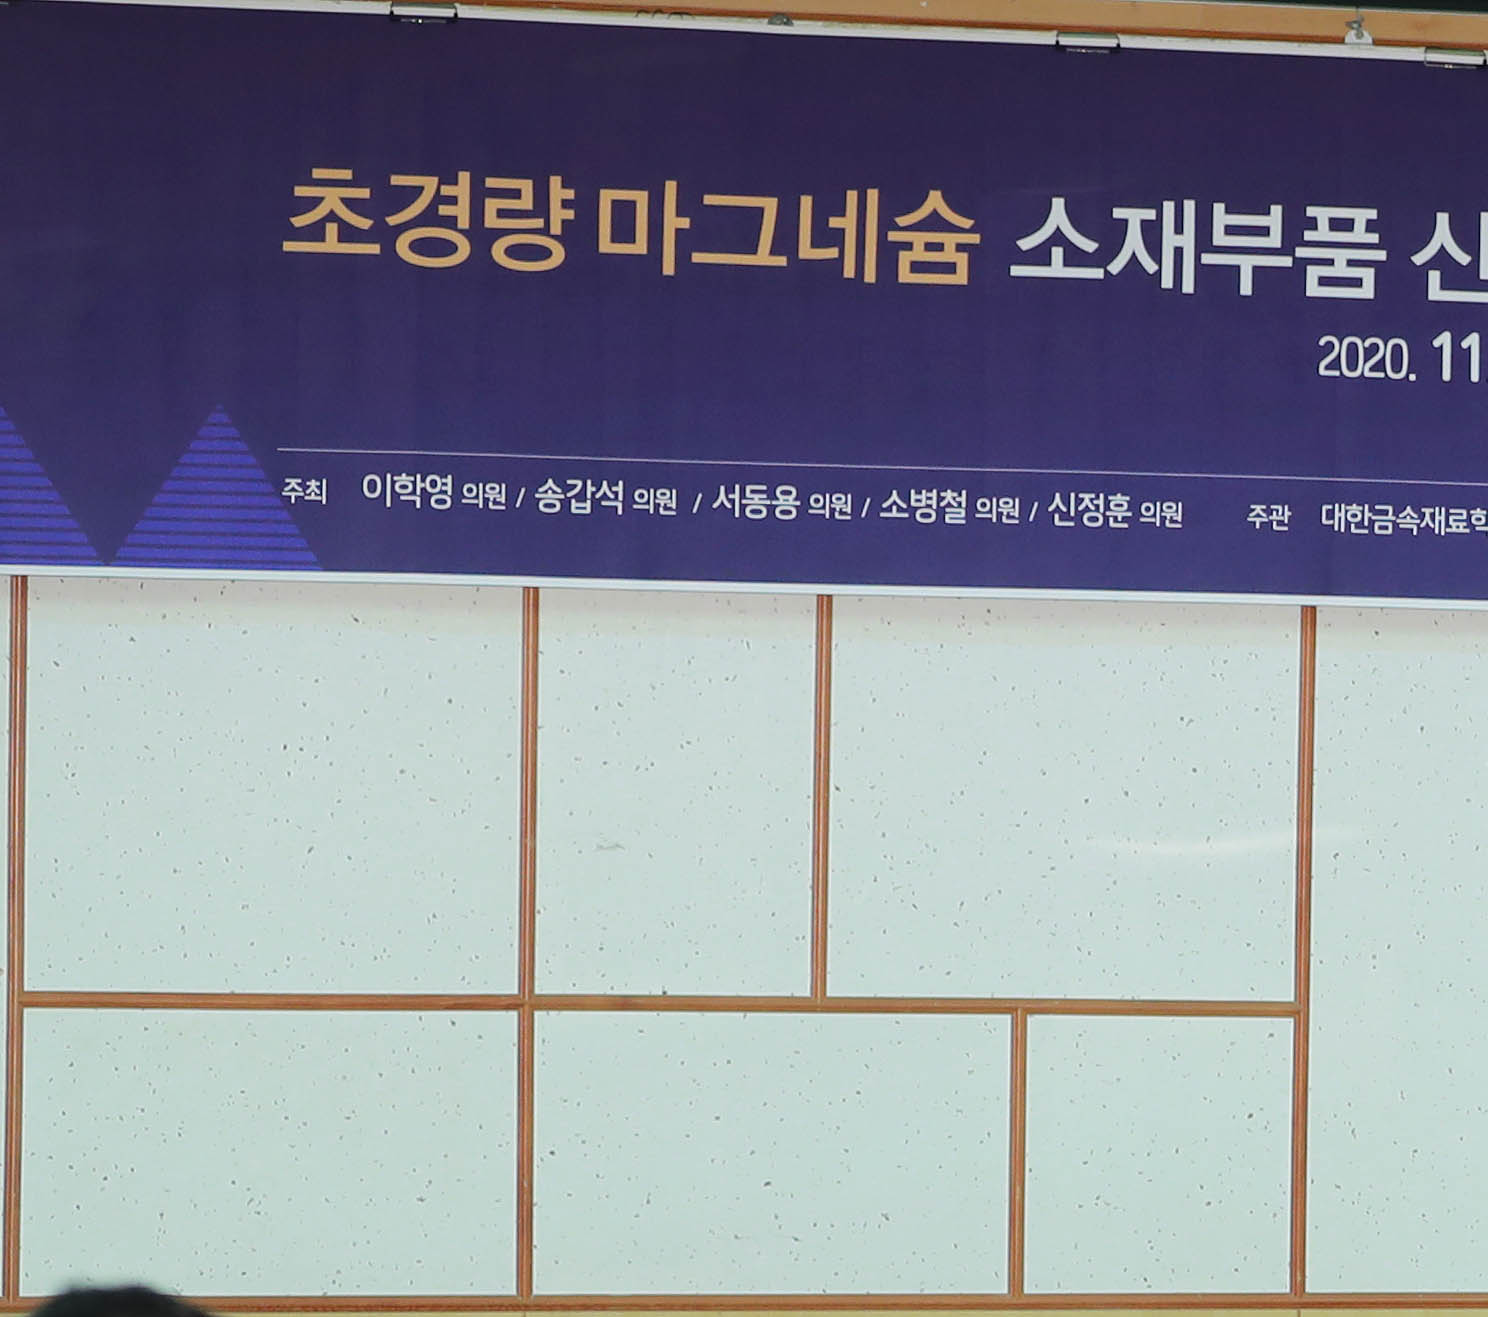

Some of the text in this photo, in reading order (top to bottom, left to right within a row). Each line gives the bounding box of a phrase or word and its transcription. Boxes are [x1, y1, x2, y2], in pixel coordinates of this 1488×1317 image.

[283, 169, 575, 271] 초경량
[598, 180, 981, 285] 마그네슘
[1010, 197, 1387, 300] 소재부품
[1318, 335, 1417, 382] 2020.
[281, 478, 327, 505] 주최
[362, 472, 453, 510] 이학영
[461, 482, 506, 510] 의원
[534, 478, 624, 516] 송갑석
[632, 487, 677, 516] 의원
[711, 483, 801, 521] 서동용
[807, 492, 852, 520] 의원
[879, 488, 967, 525] 소병철
[974, 496, 1020, 524] 의원
[1047, 491, 1133, 529] 신정훈
[1139, 501, 1183, 529] 의원
[1246, 504, 1293, 531] 주관
